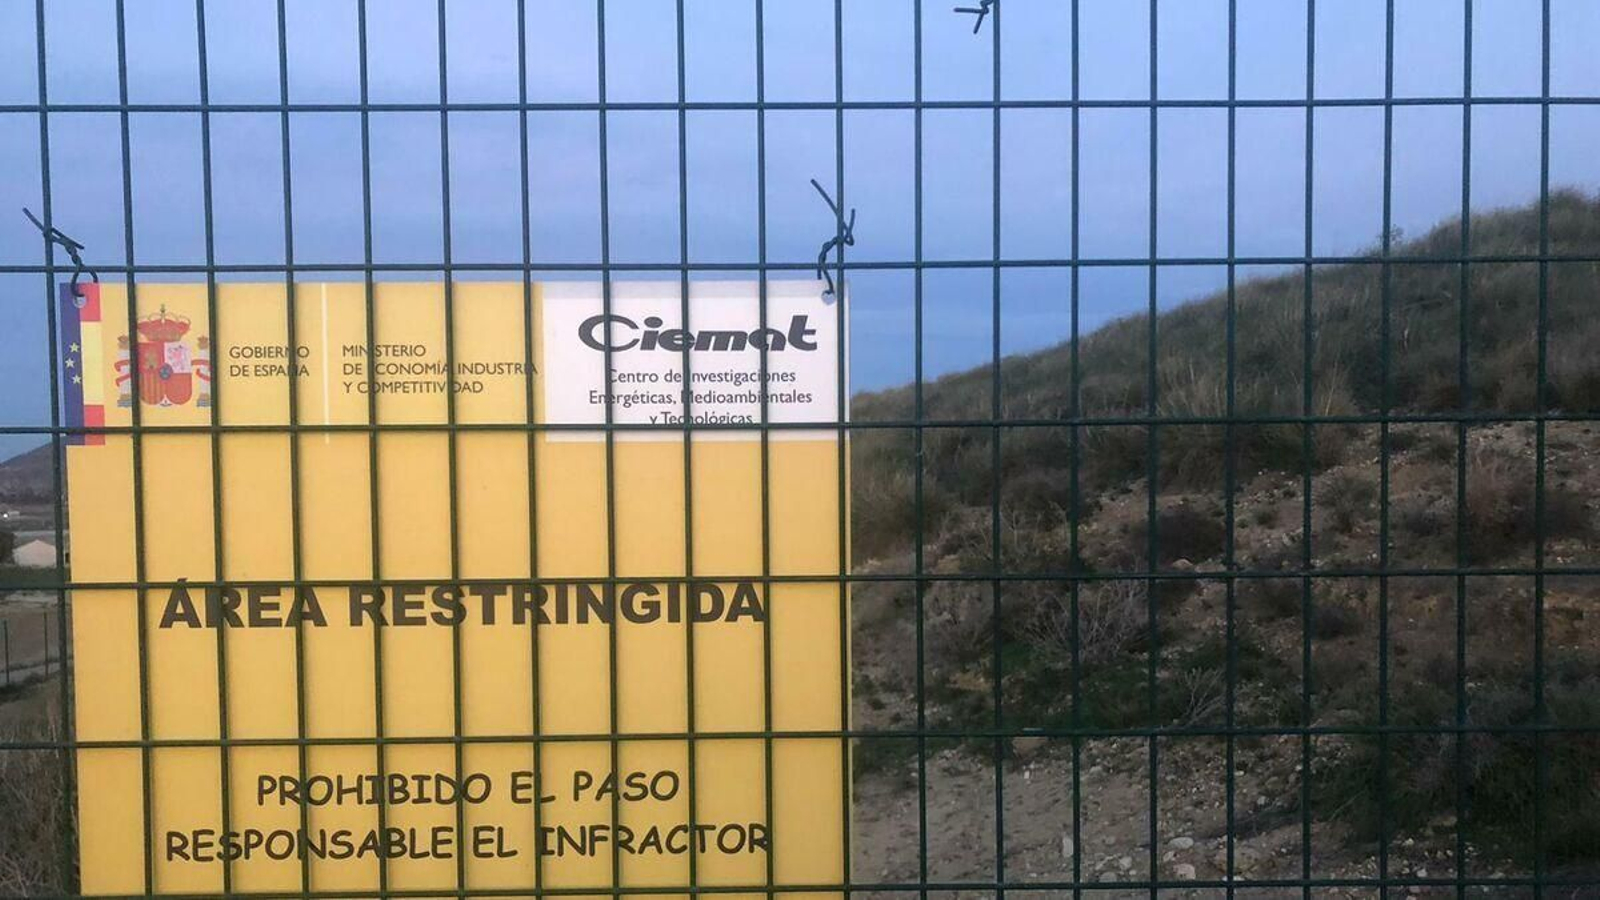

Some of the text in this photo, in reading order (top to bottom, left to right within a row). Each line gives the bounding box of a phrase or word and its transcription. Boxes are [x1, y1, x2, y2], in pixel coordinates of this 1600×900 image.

[578, 314, 817, 352] Ciemat
[230, 363, 310, 377] DE ESPAA
[343, 363, 363, 375] DE
[664, 369, 682, 383] de
[343, 382, 353, 393] Y
[159, 577, 767, 628] ÁREA RESTRINGIDA
[258, 772, 492, 806] PROHIBIDO
[573, 770, 679, 801] PASO
[166, 823, 770, 862] RESPONSABLE EL INFRACTOR
